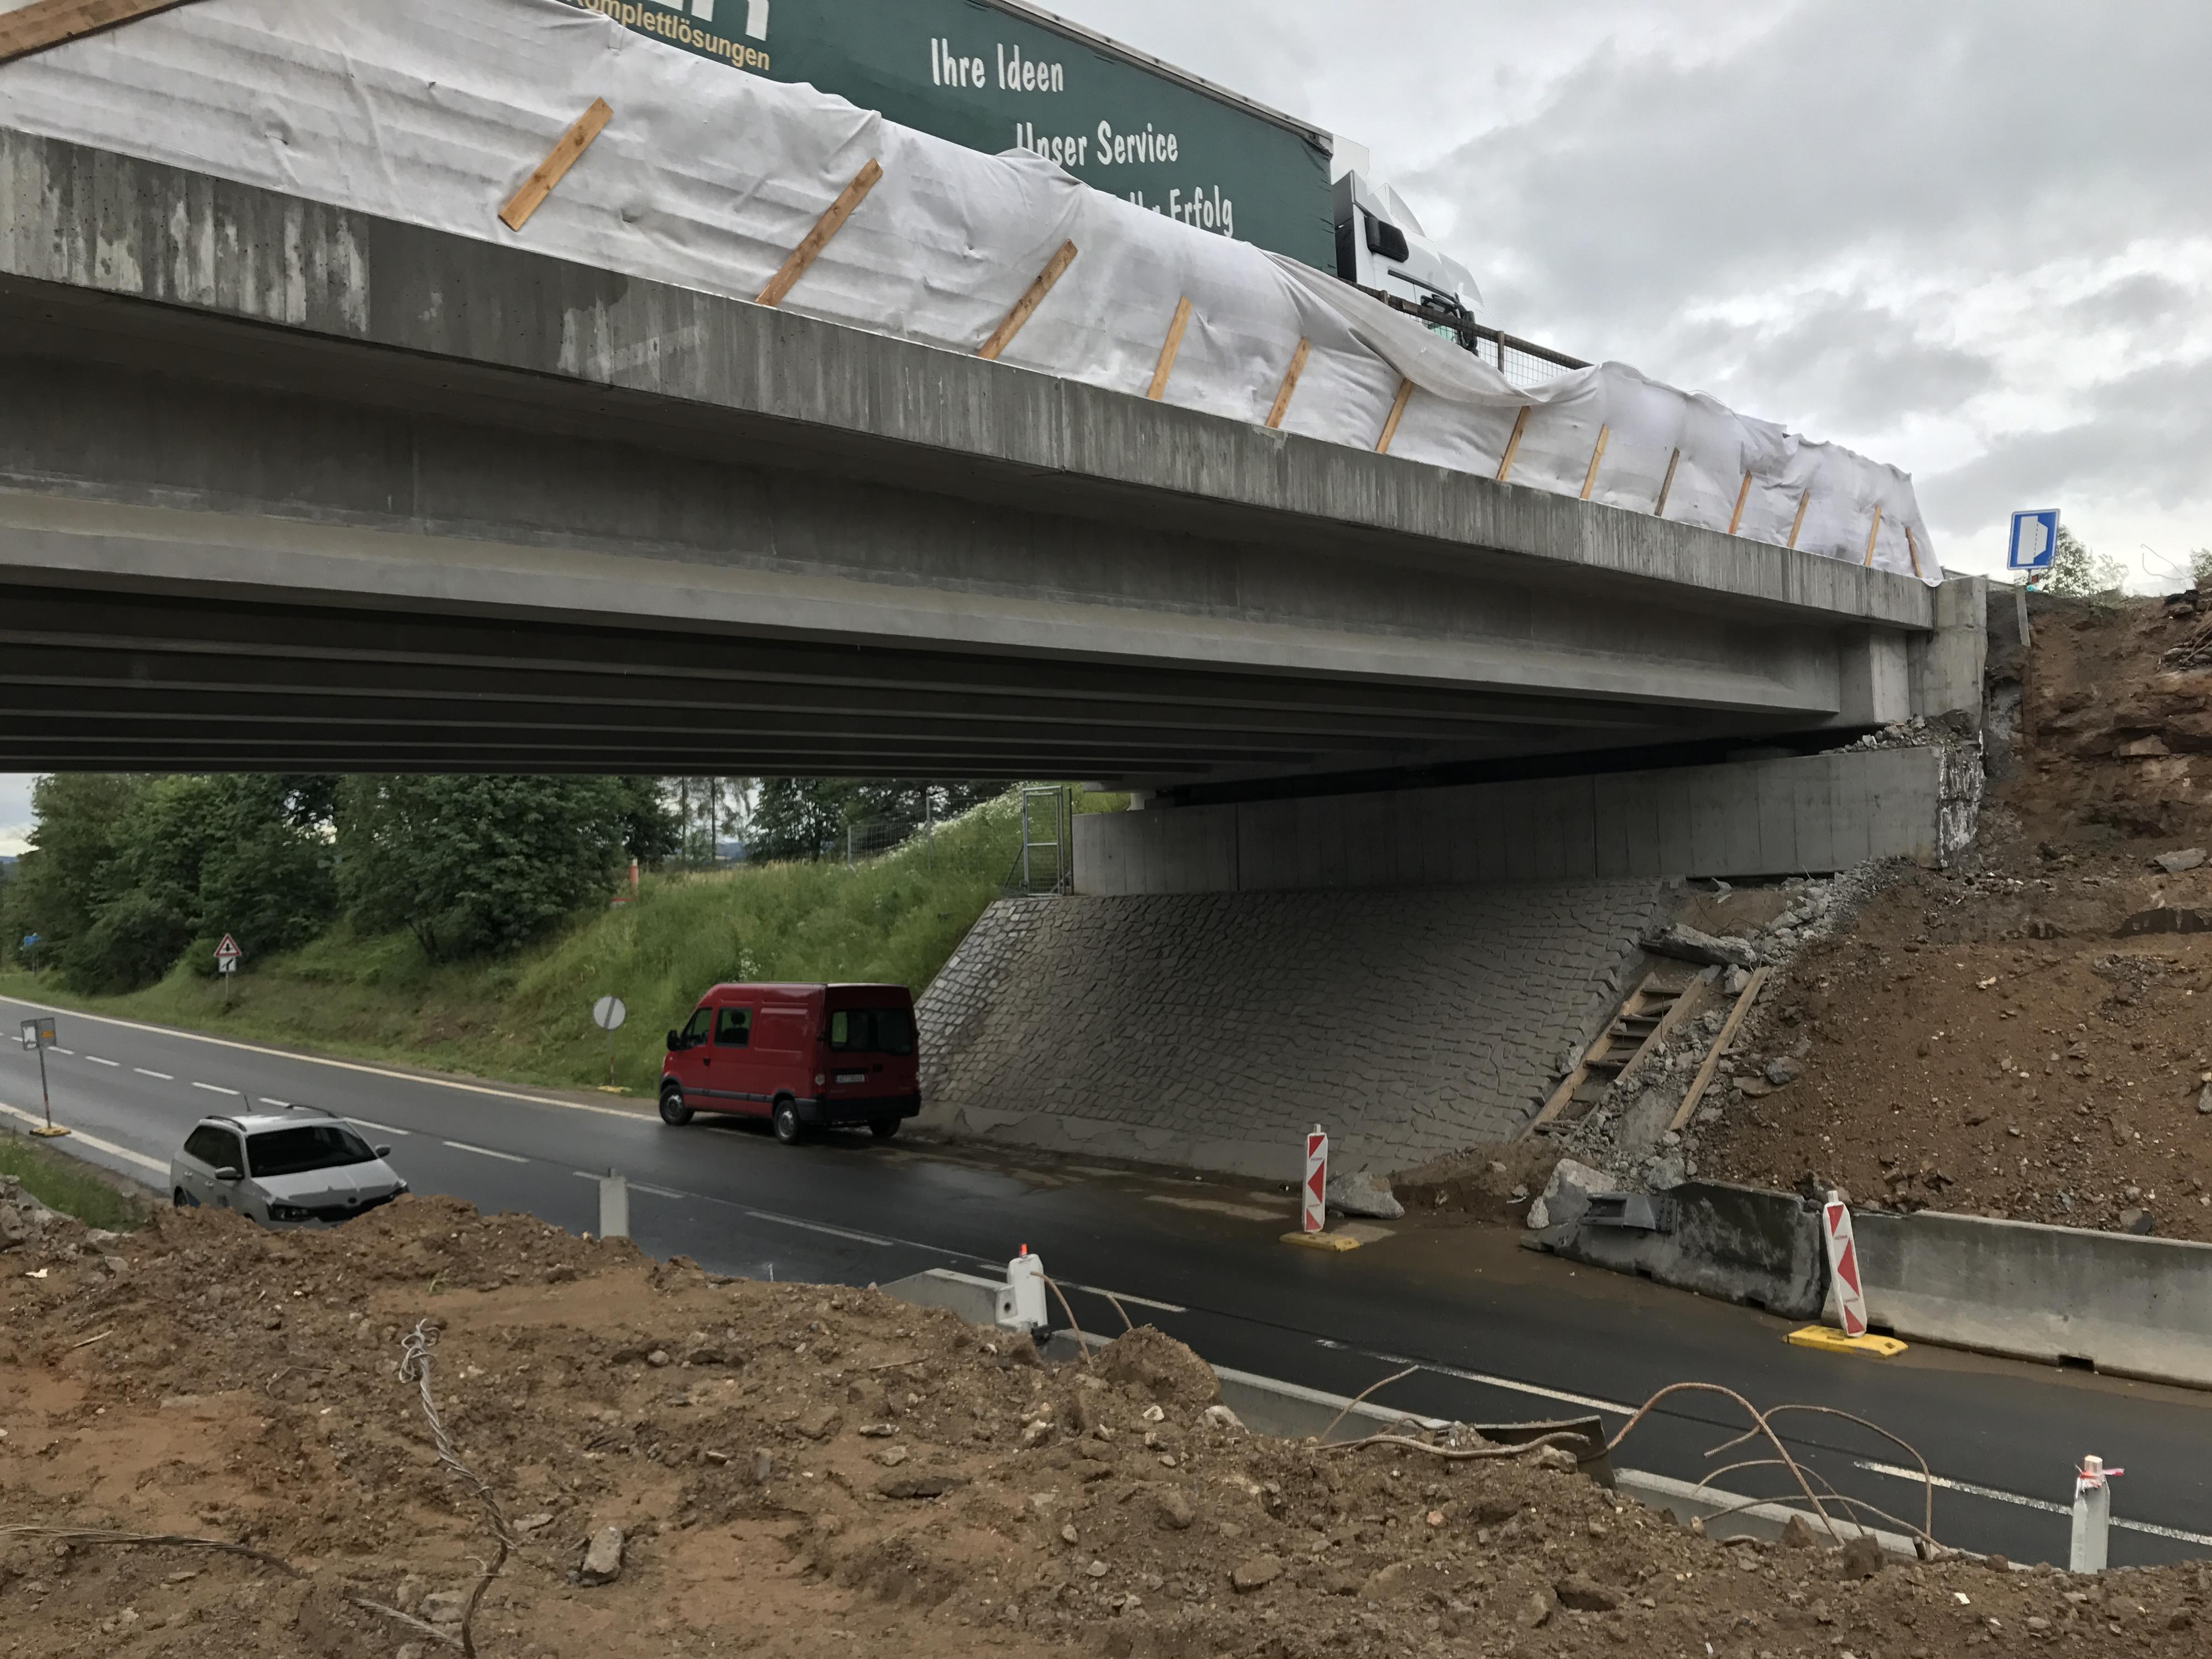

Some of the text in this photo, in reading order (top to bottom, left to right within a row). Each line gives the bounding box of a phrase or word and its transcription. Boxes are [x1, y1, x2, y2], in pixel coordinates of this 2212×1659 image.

[931, 38, 1063, 92] Ihre Ideen
[1097, 121, 1178, 165] Service
[1170, 185, 1233, 238] Erfolg
